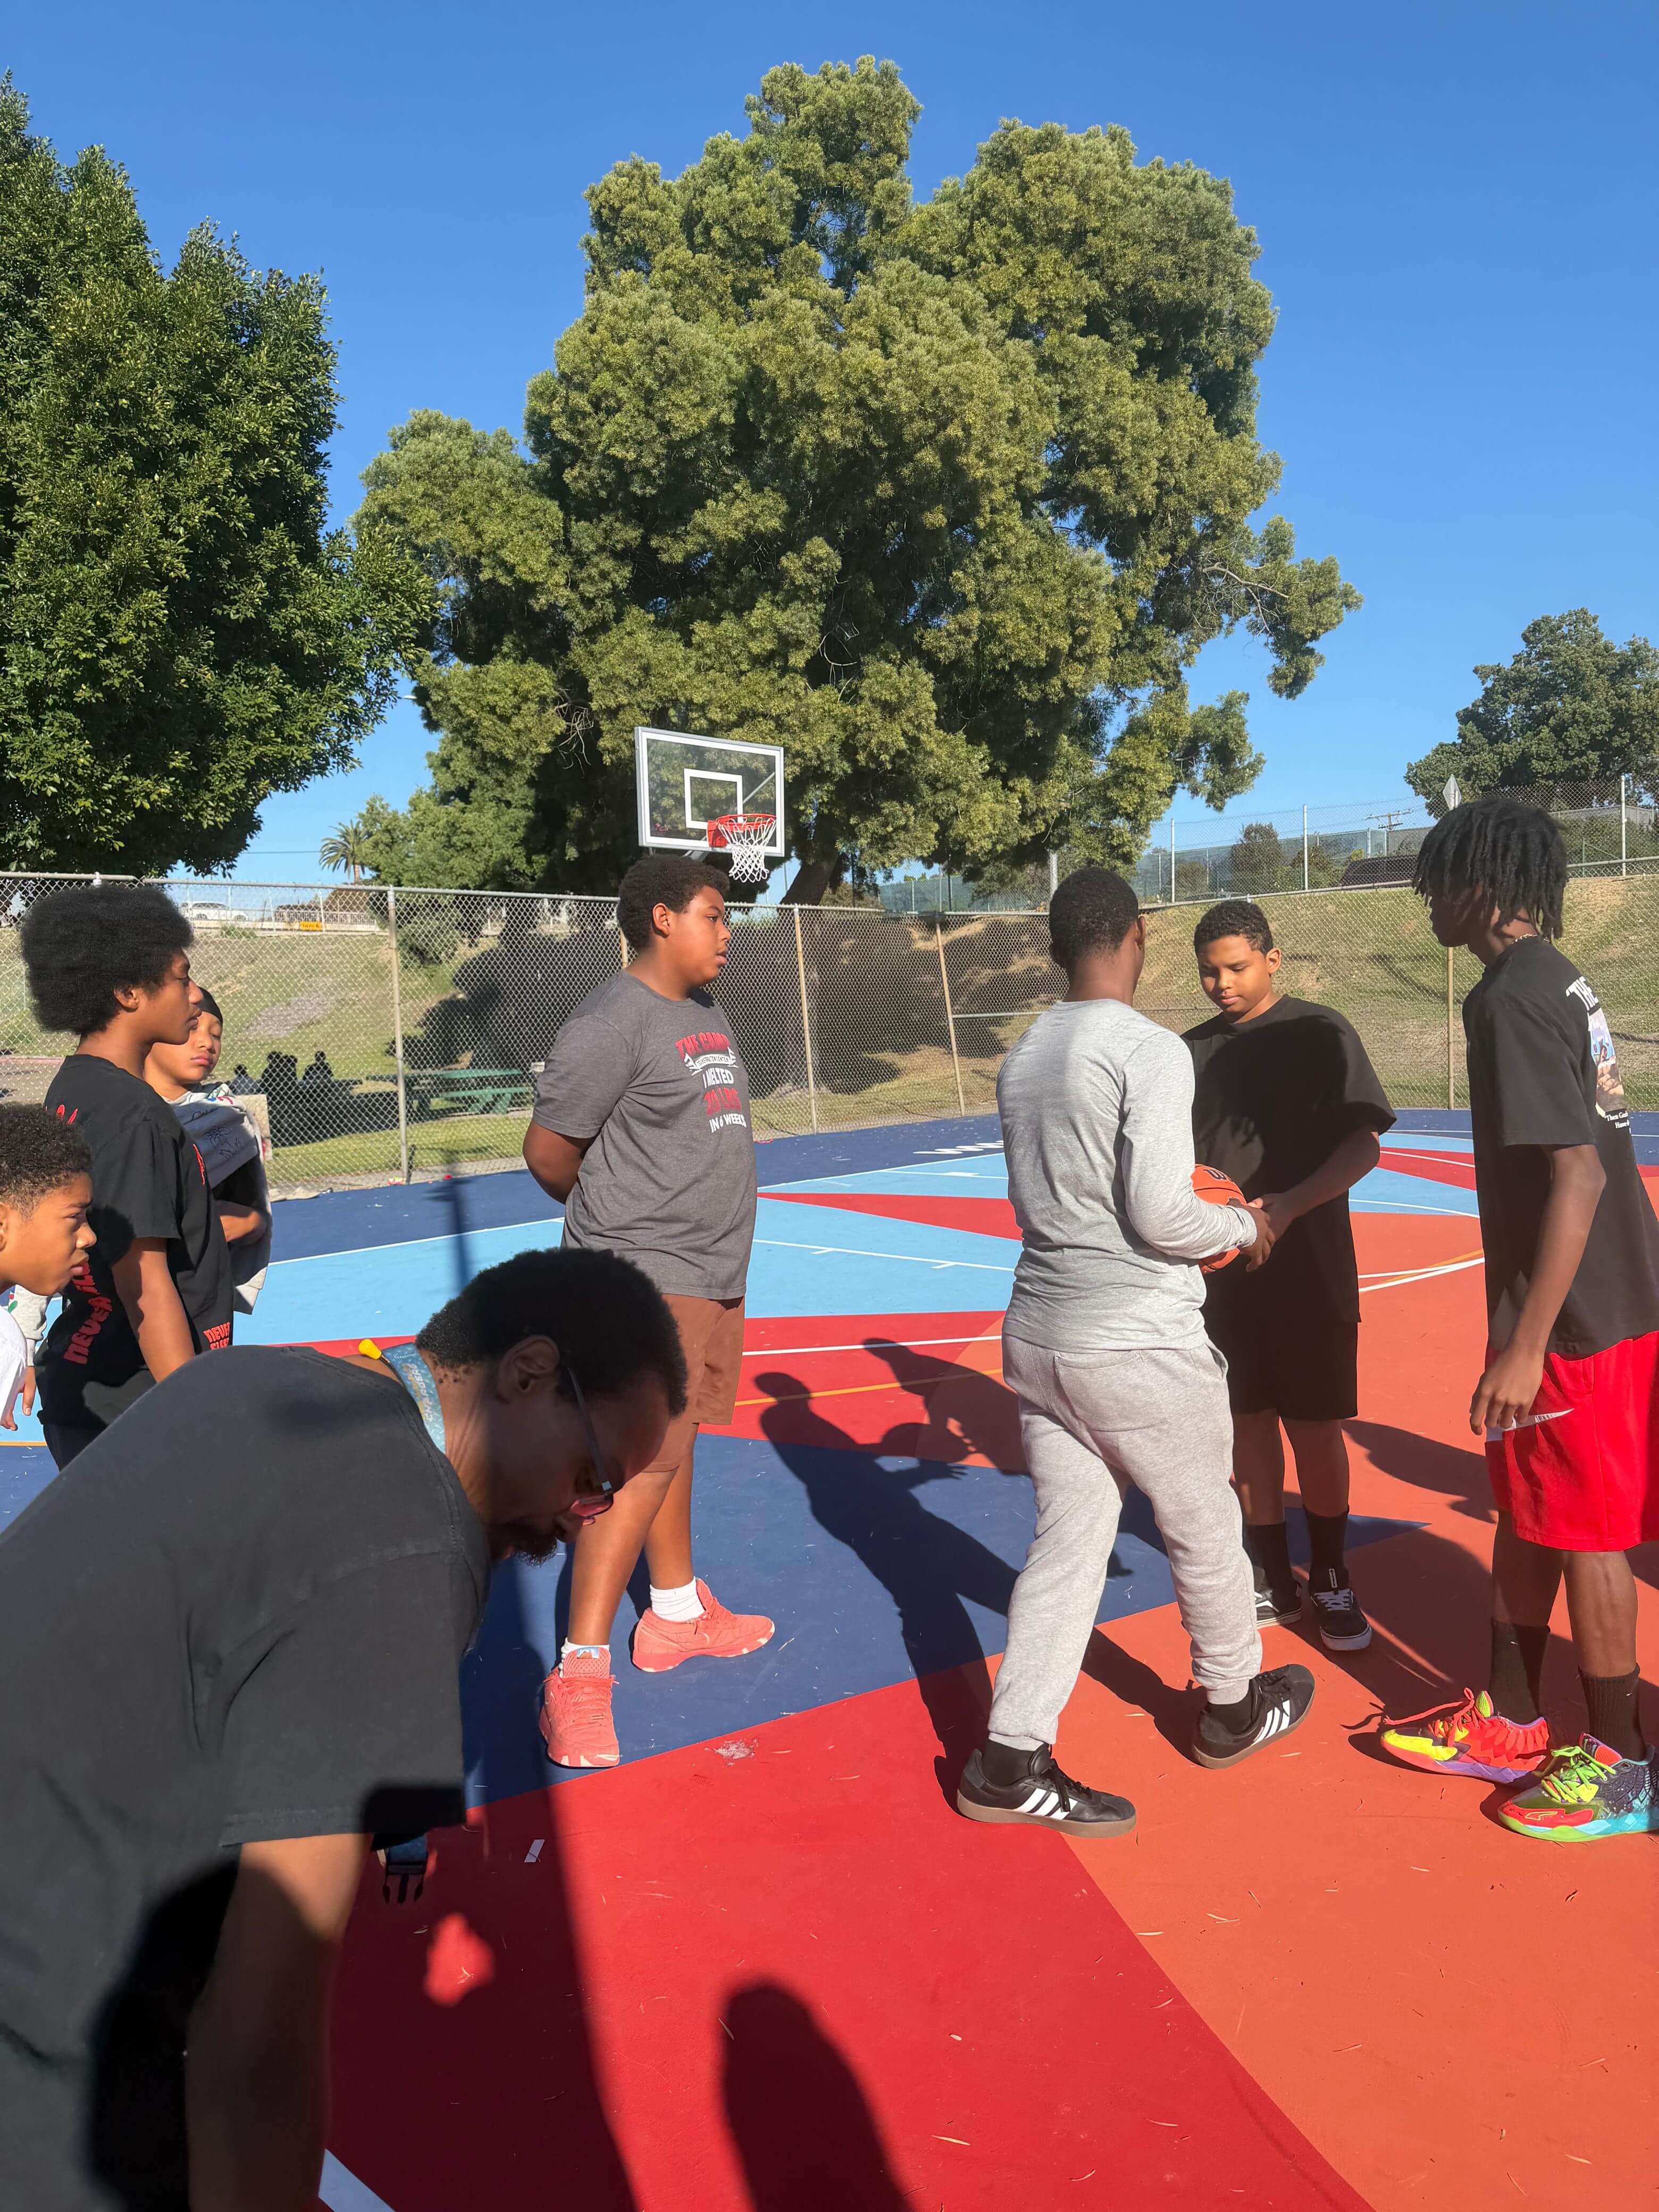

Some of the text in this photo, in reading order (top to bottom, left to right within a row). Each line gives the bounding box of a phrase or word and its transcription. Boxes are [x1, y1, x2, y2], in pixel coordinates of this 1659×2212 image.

[675, 1034, 702, 1063] THE
[698, 1032, 731, 1051] CAMP
[703, 1067, 734, 1088] I MELTED
[709, 1113, 747, 1133] IN 6 WEEKS
